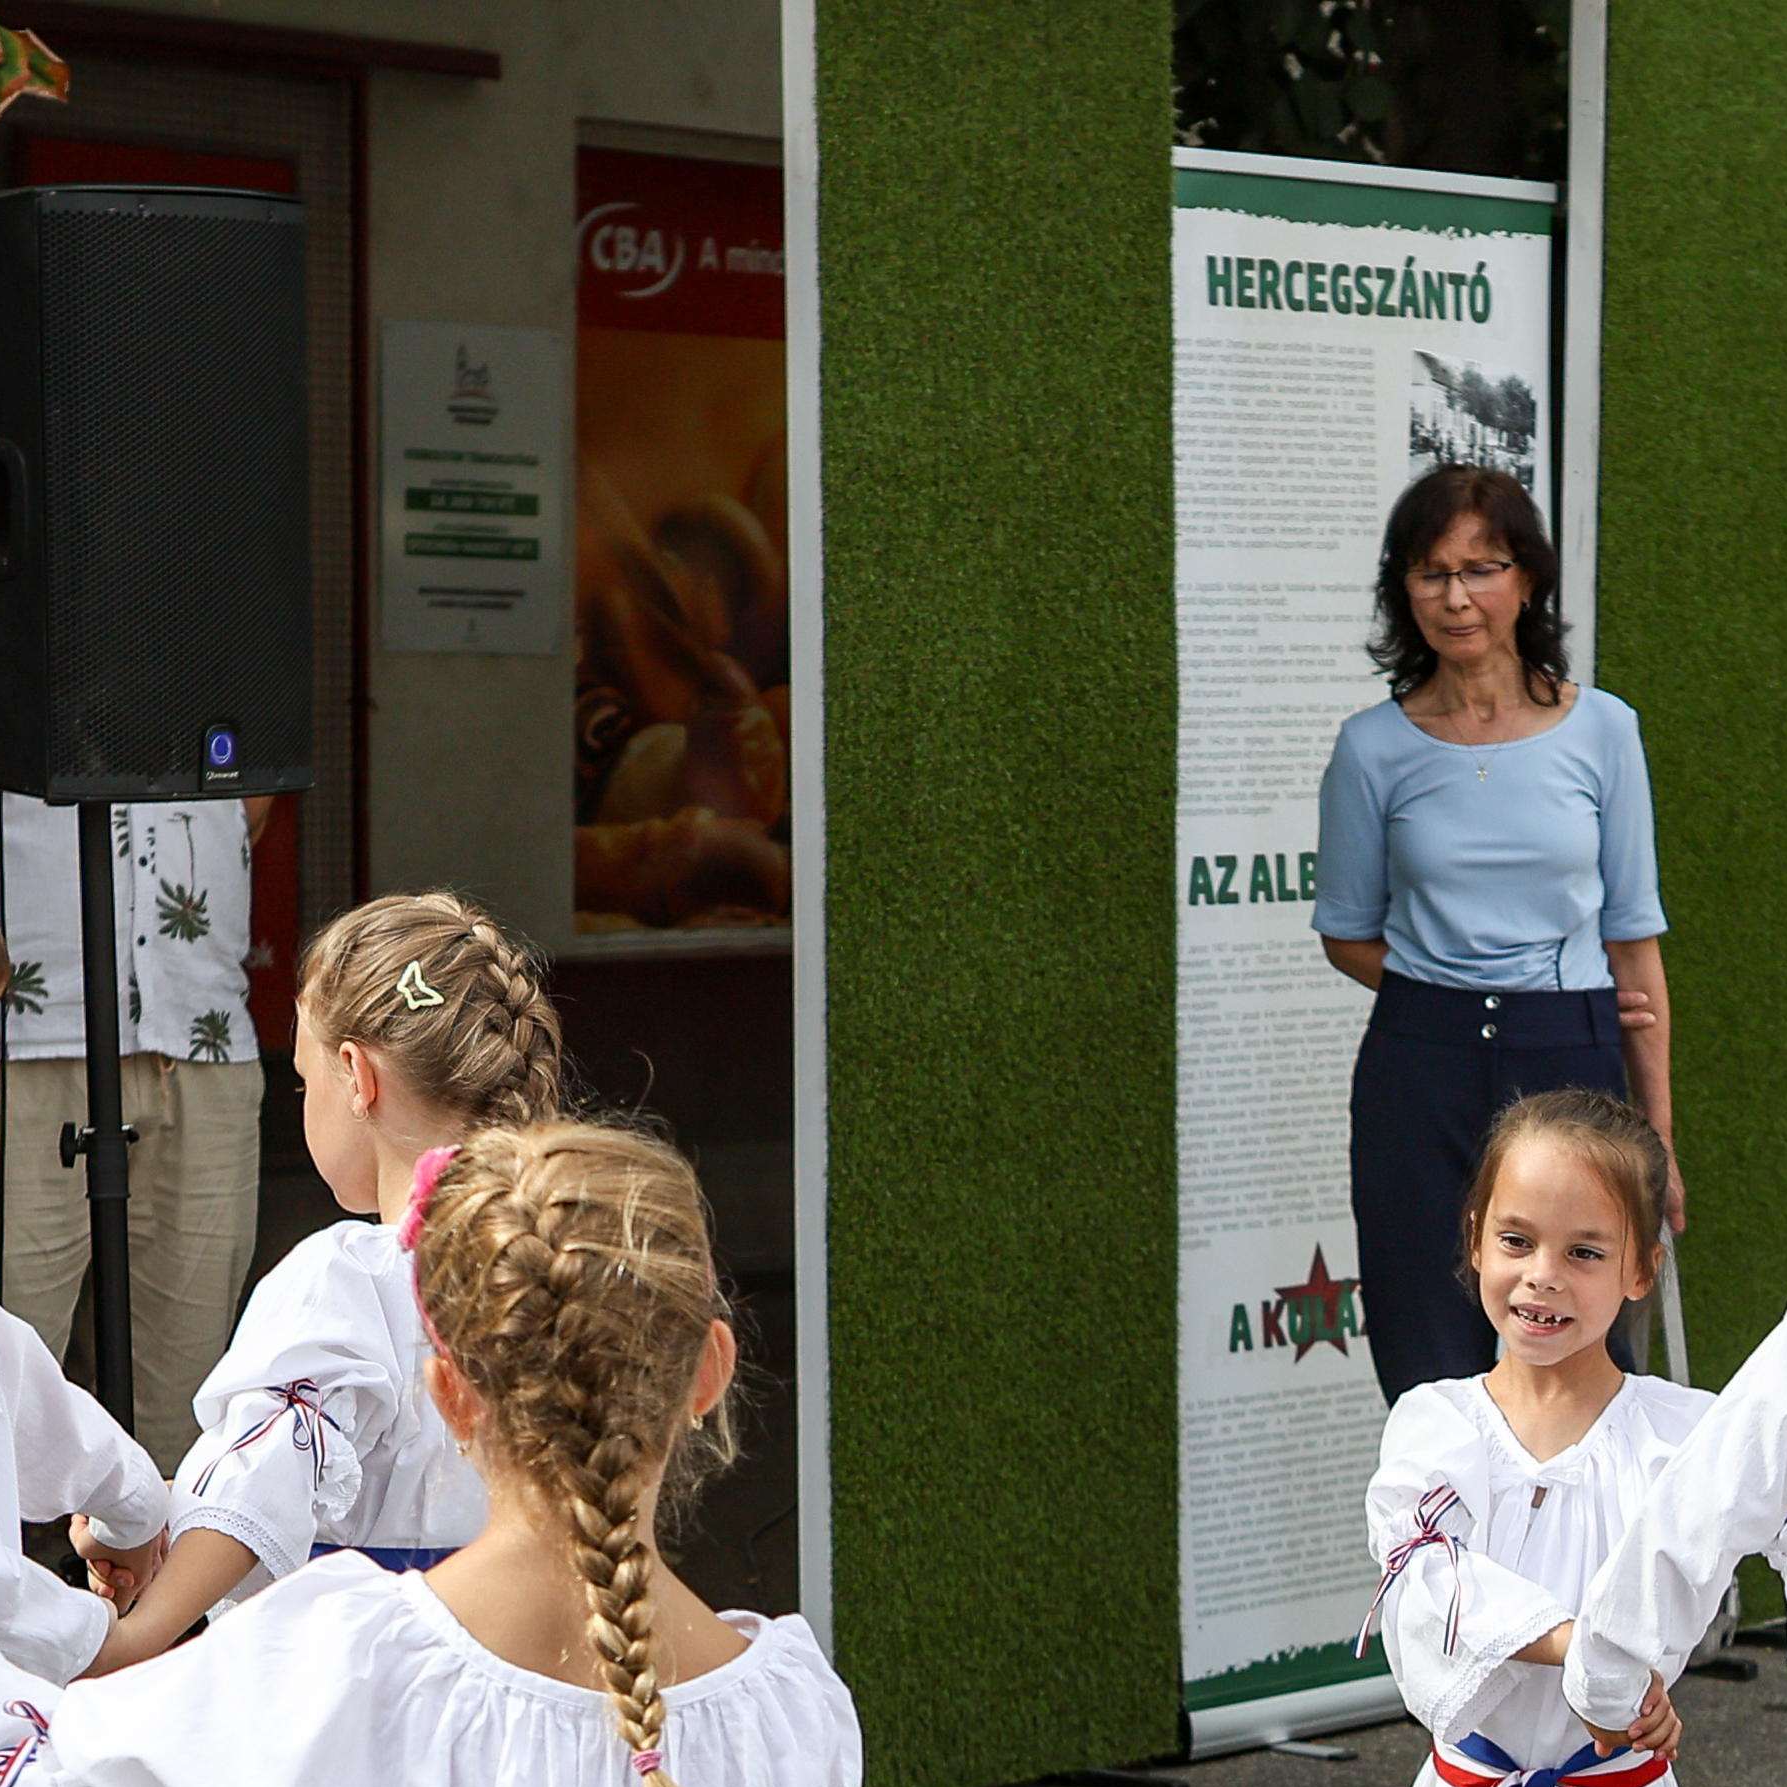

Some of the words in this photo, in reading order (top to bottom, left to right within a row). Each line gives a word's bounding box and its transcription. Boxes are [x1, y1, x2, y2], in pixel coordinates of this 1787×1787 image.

[591, 225, 665, 273] CBA
[698, 237, 720, 270] A
[1207, 256, 1491, 324] HERCEGSZÁNTÓ
[1189, 855, 1240, 906] AZ
[1229, 1303, 1254, 1353] A
[1261, 1276, 1368, 1348] KULÁ
